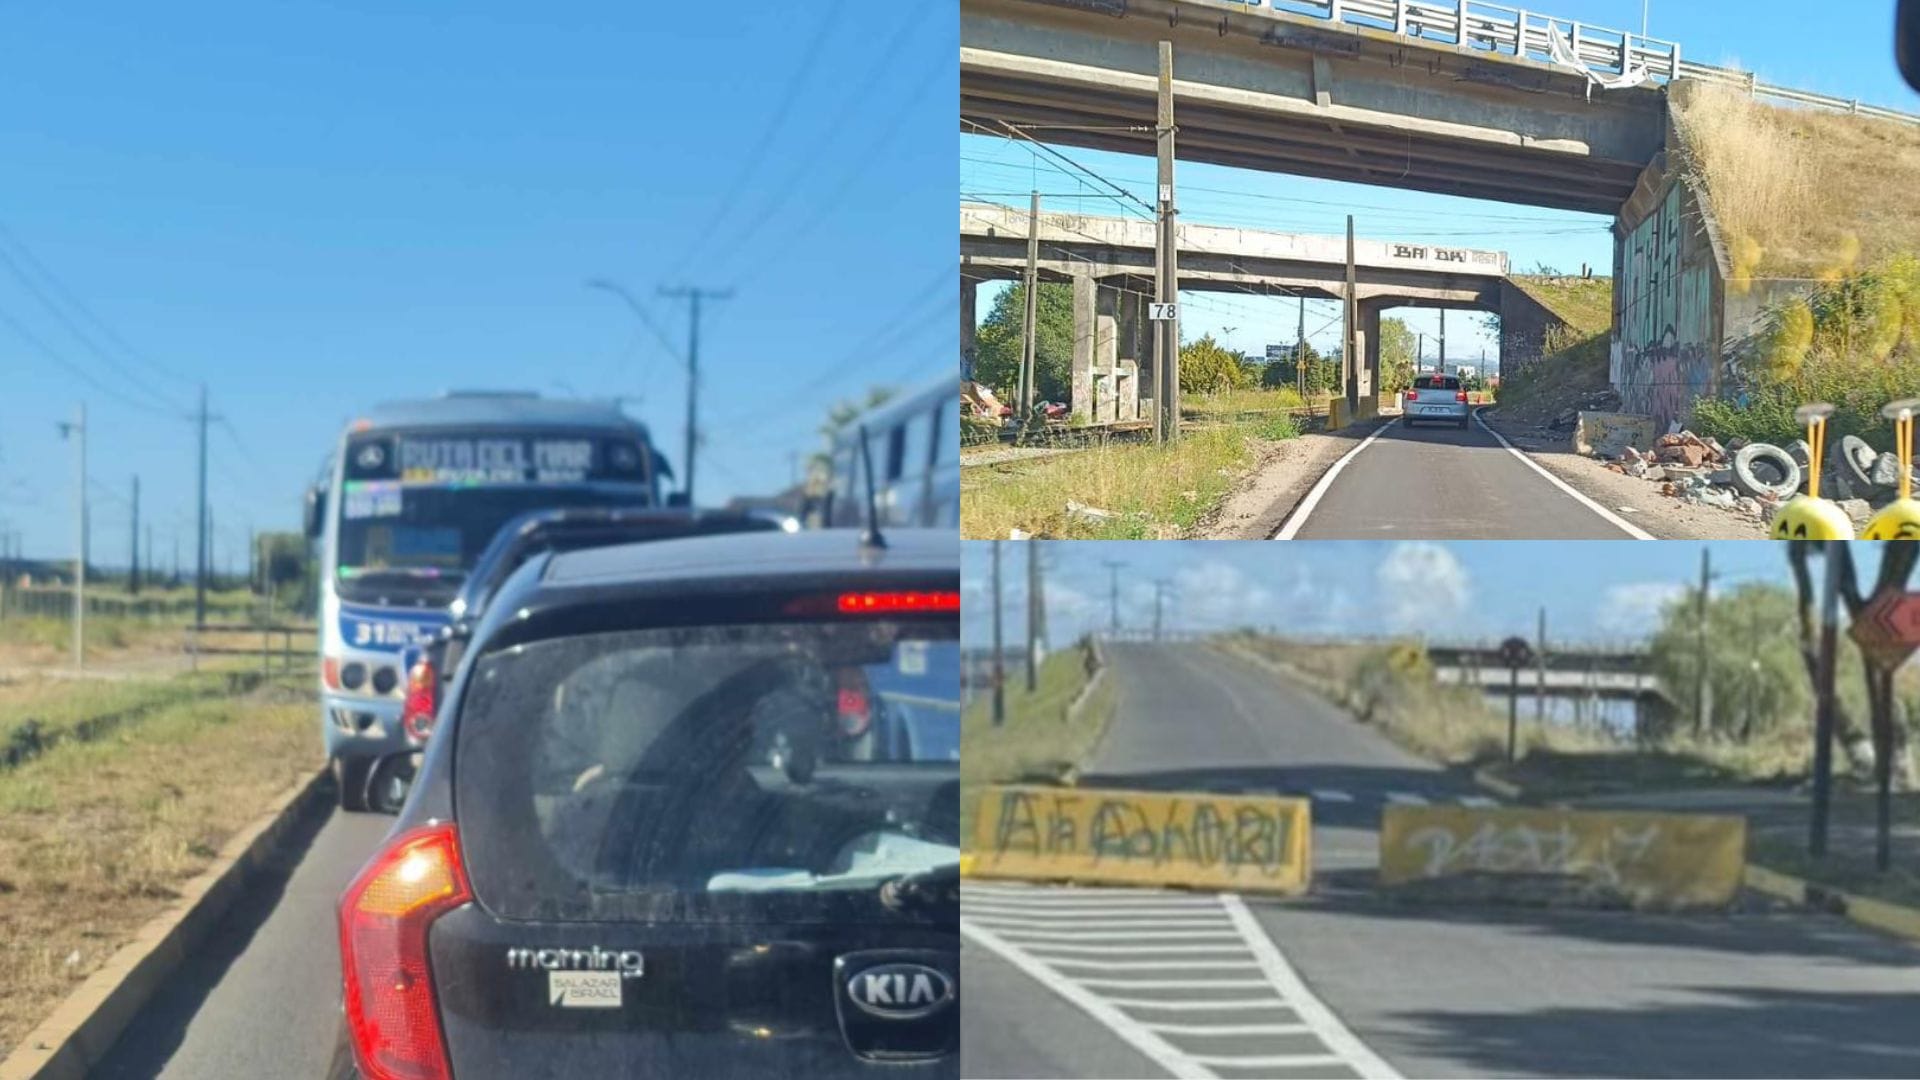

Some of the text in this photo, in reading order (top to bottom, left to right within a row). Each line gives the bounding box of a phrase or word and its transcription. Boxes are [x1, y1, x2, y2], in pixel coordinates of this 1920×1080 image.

[1154, 304, 1177, 318] 78
[507, 945, 644, 978] morning
[864, 973, 935, 1004] KIA
